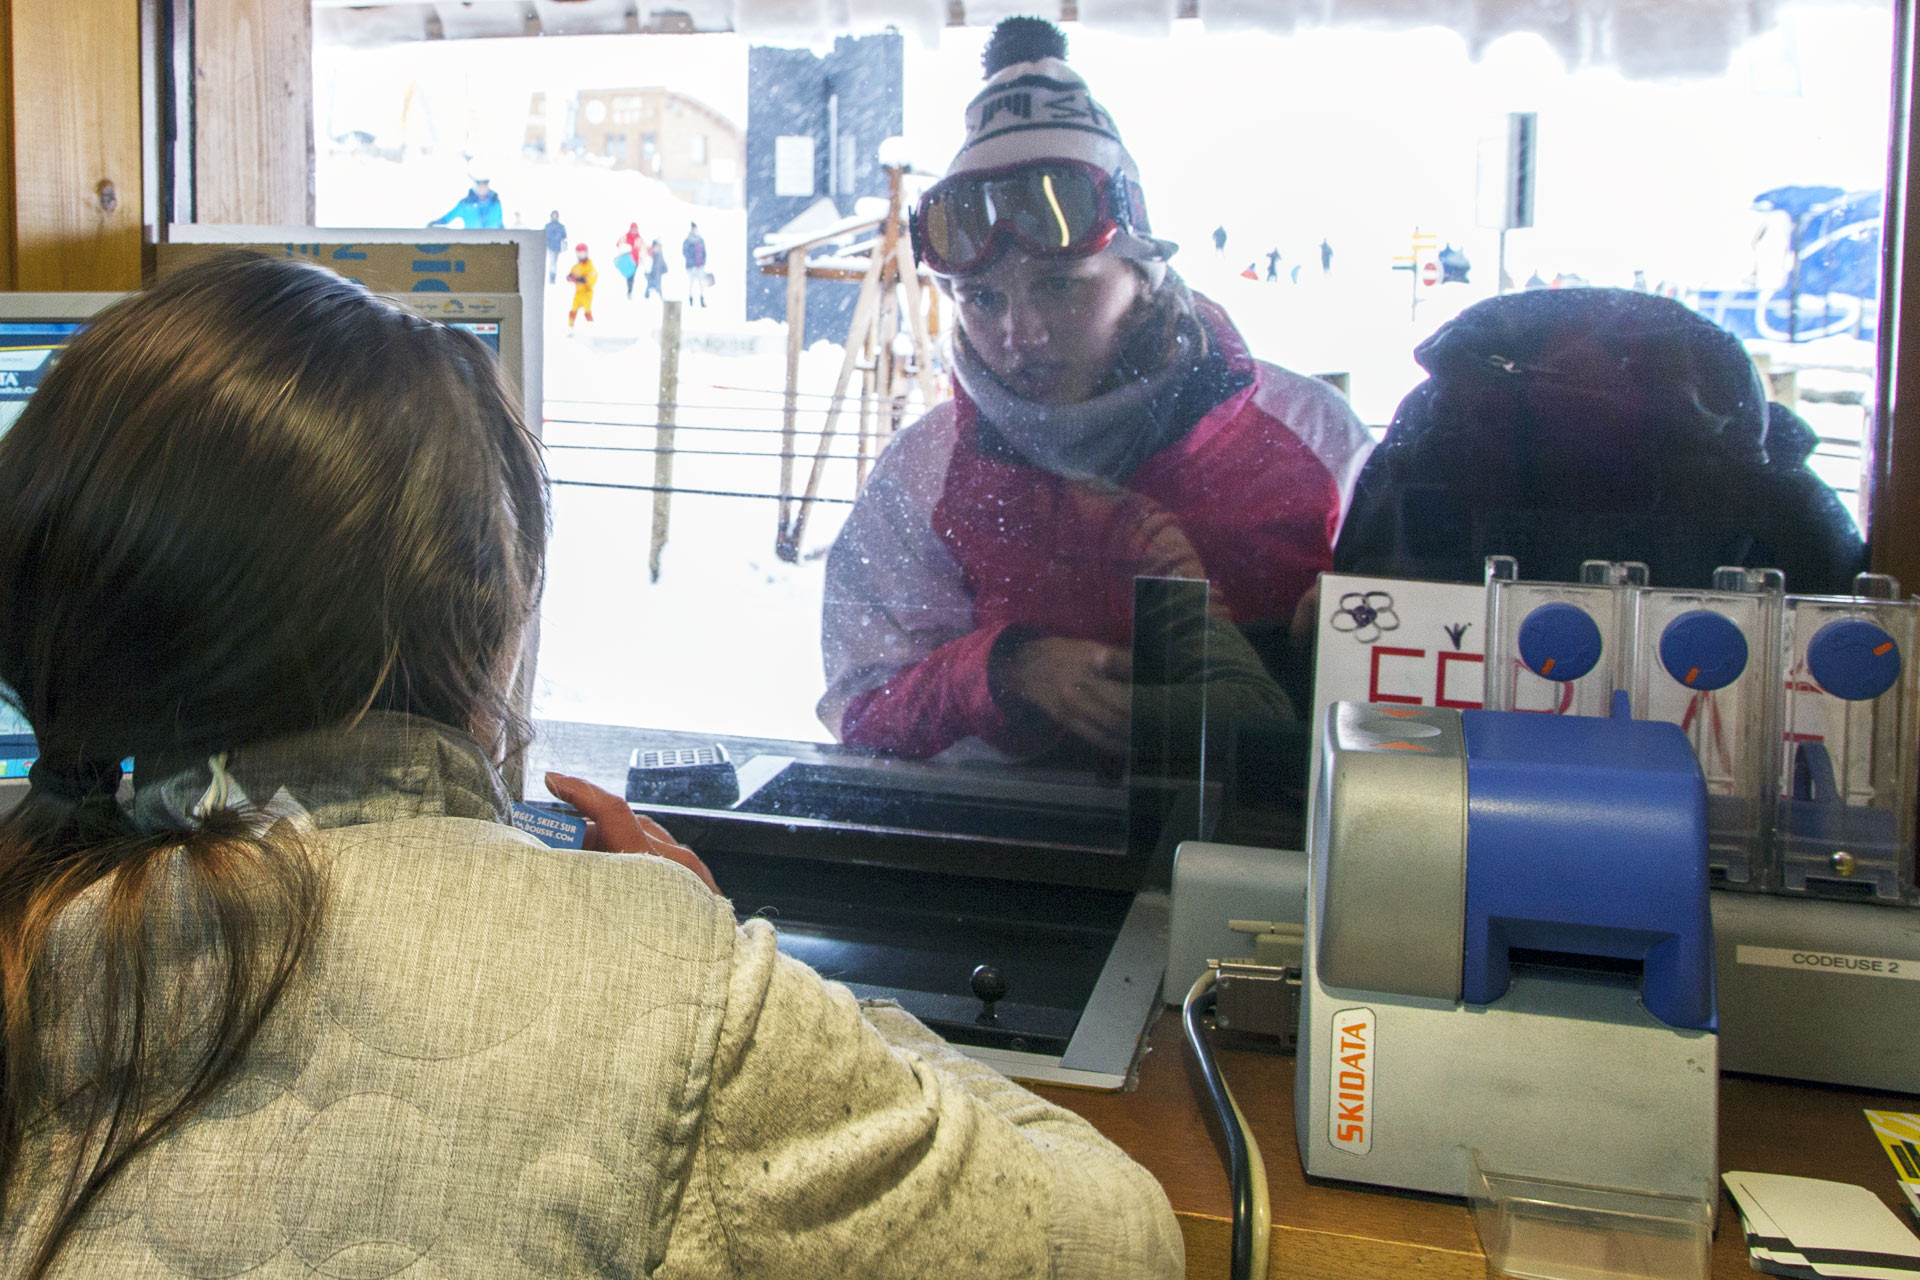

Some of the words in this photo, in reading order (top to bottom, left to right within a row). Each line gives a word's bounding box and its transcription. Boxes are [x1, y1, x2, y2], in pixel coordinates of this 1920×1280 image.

[537, 817, 560, 829] SKIEZ
[560, 822, 577, 834] SUR
[1792, 953, 1882, 972] CODEUSE
[1888, 962, 1899, 973] 2
[1337, 1022, 1366, 1143] SKIDATA
